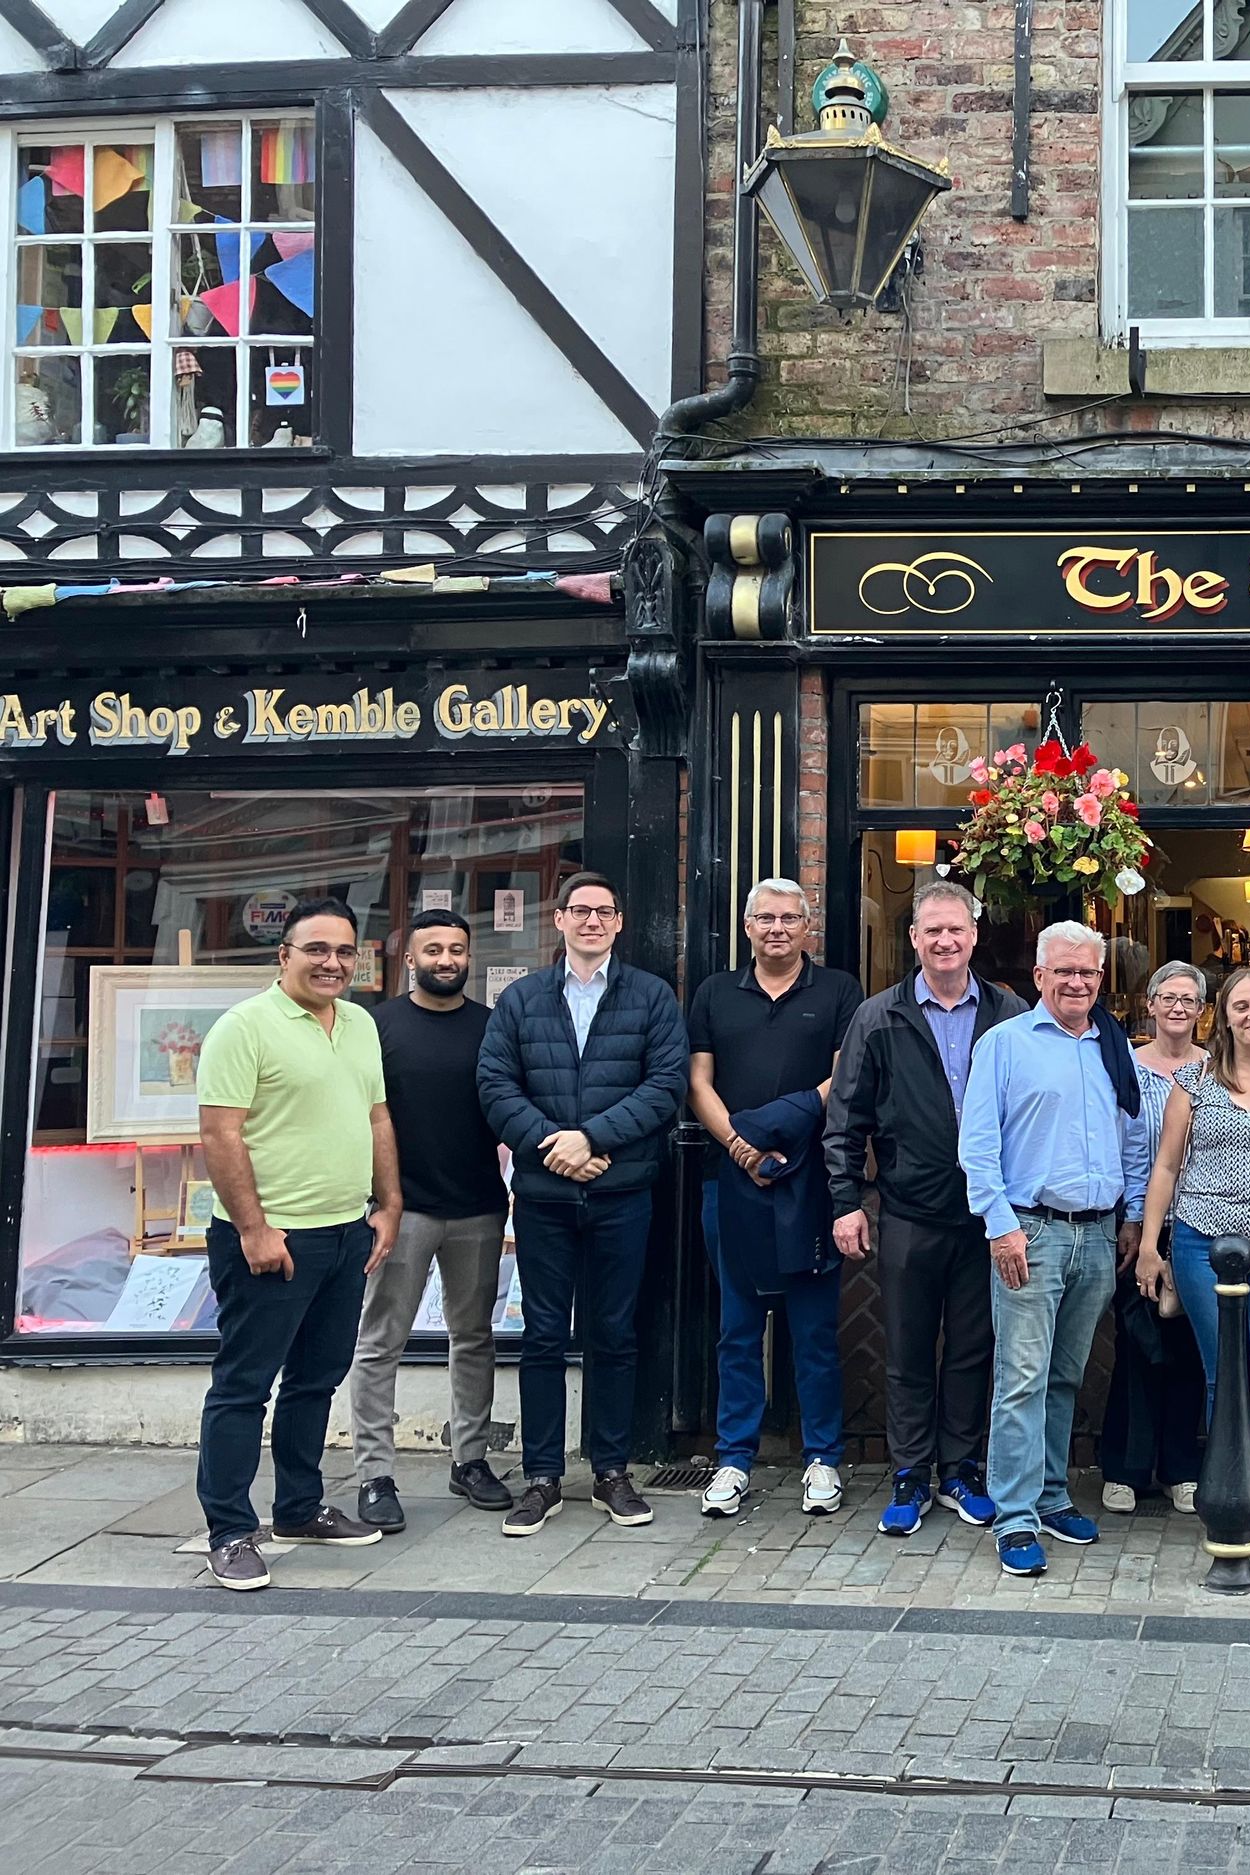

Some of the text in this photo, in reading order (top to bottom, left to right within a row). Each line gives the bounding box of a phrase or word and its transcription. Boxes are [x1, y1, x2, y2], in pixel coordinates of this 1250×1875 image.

[1057, 546, 1229, 623] The
[0, 694, 77, 746] Art
[89, 691, 201, 756] Shop
[213, 706, 242, 739] &
[242, 688, 421, 744] Kemble
